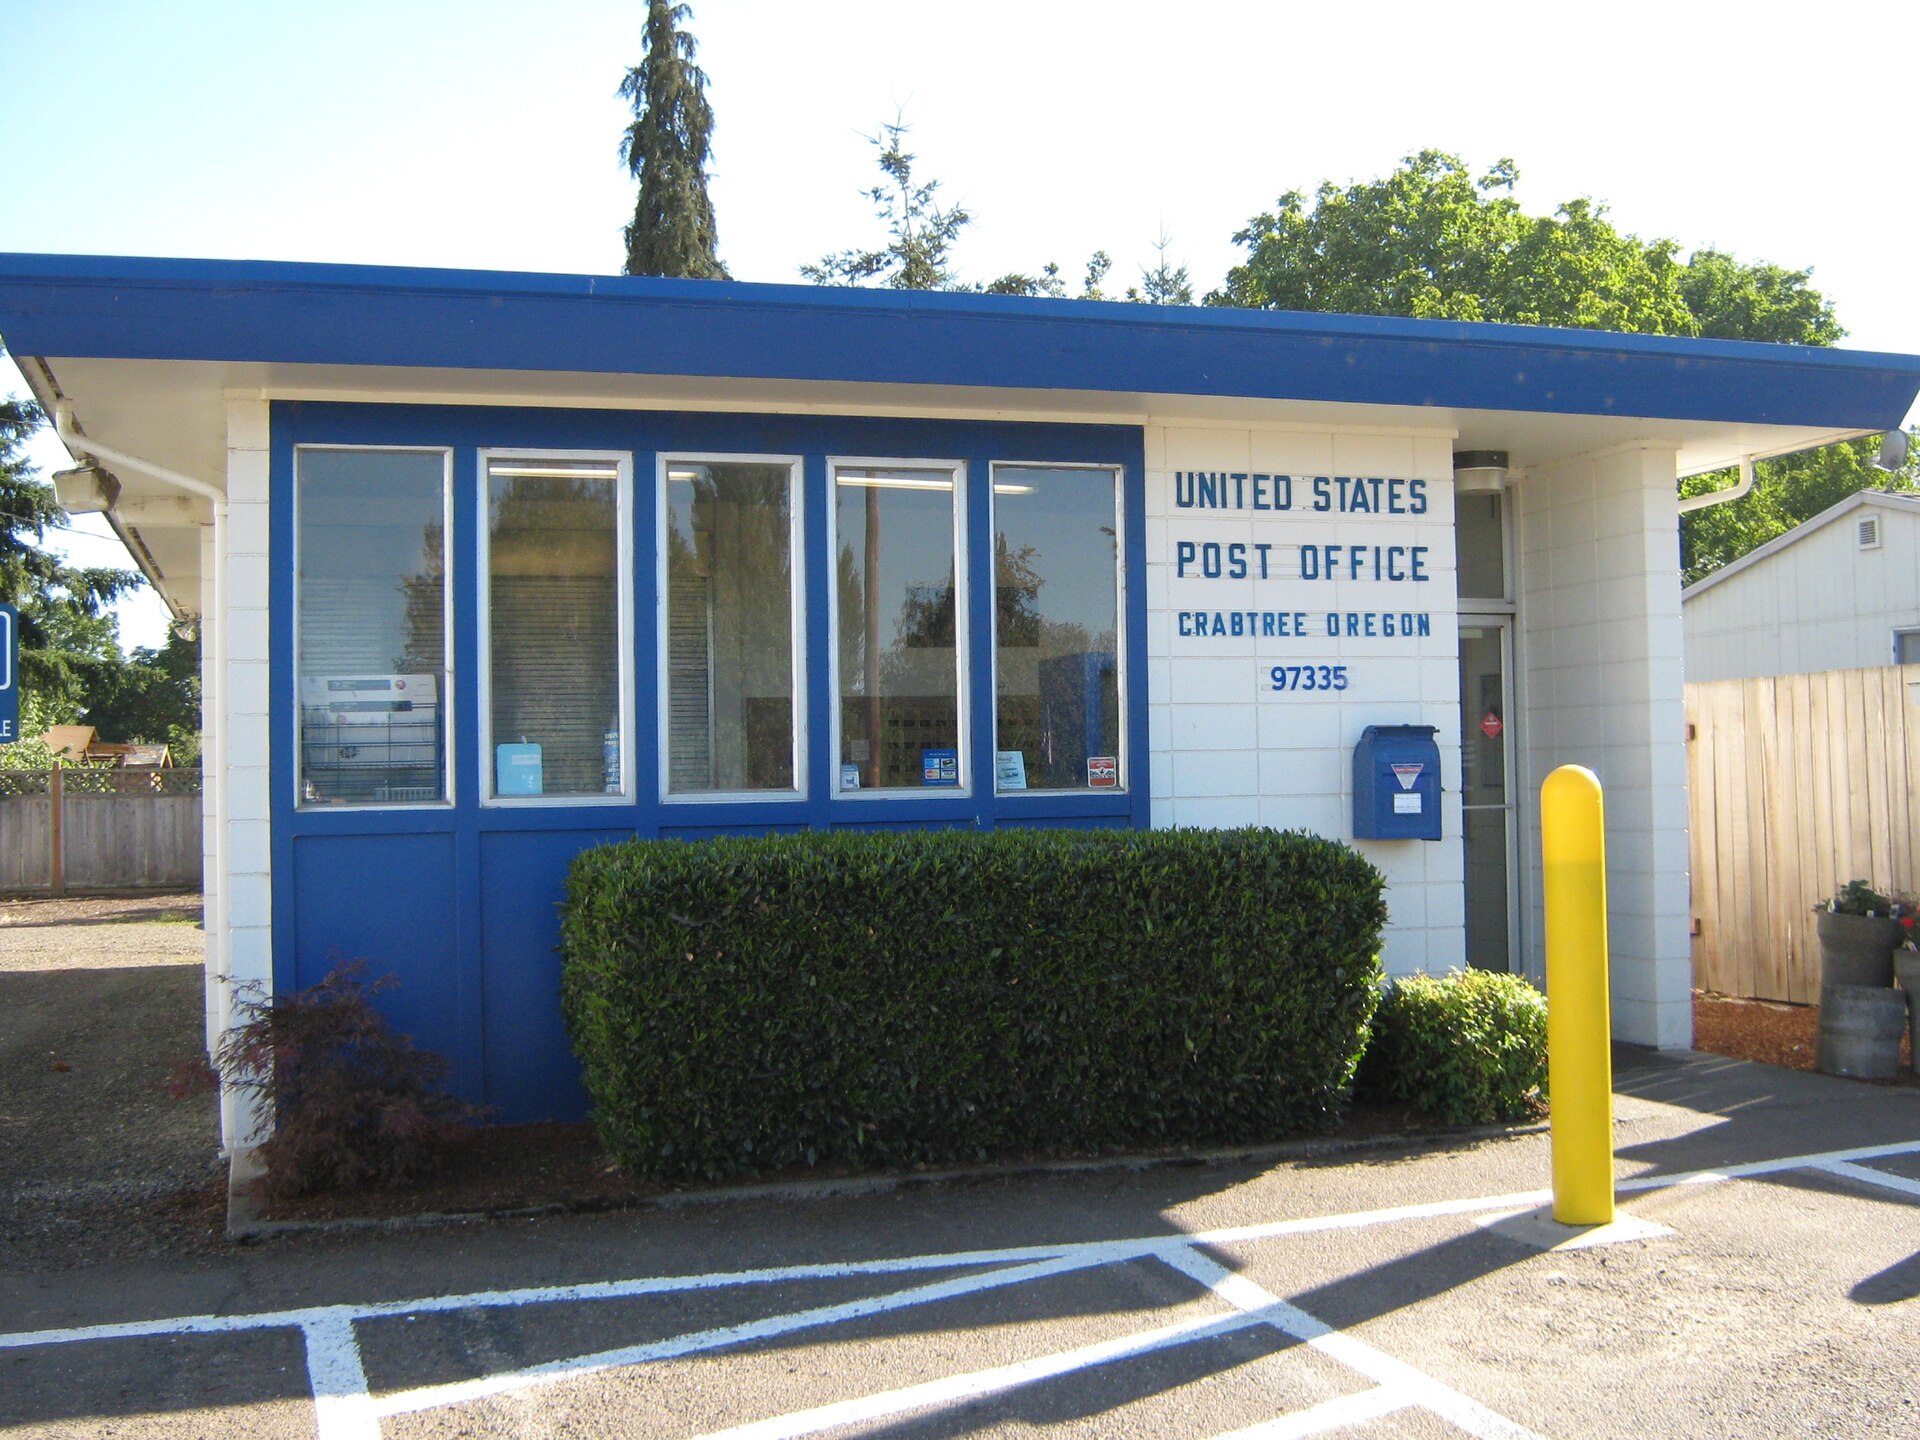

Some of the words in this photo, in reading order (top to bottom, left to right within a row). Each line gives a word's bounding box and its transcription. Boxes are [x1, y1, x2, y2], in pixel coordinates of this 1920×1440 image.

[1176, 472, 1292, 510] UNITED
[1313, 476, 1427, 514] STATES
[1177, 541, 1272, 579] POST
[1301, 545, 1429, 581] OFFICE
[1178, 611, 1306, 637] CRABTREE
[1327, 613, 1430, 637] OREGON
[1270, 665, 1348, 691] 97335
